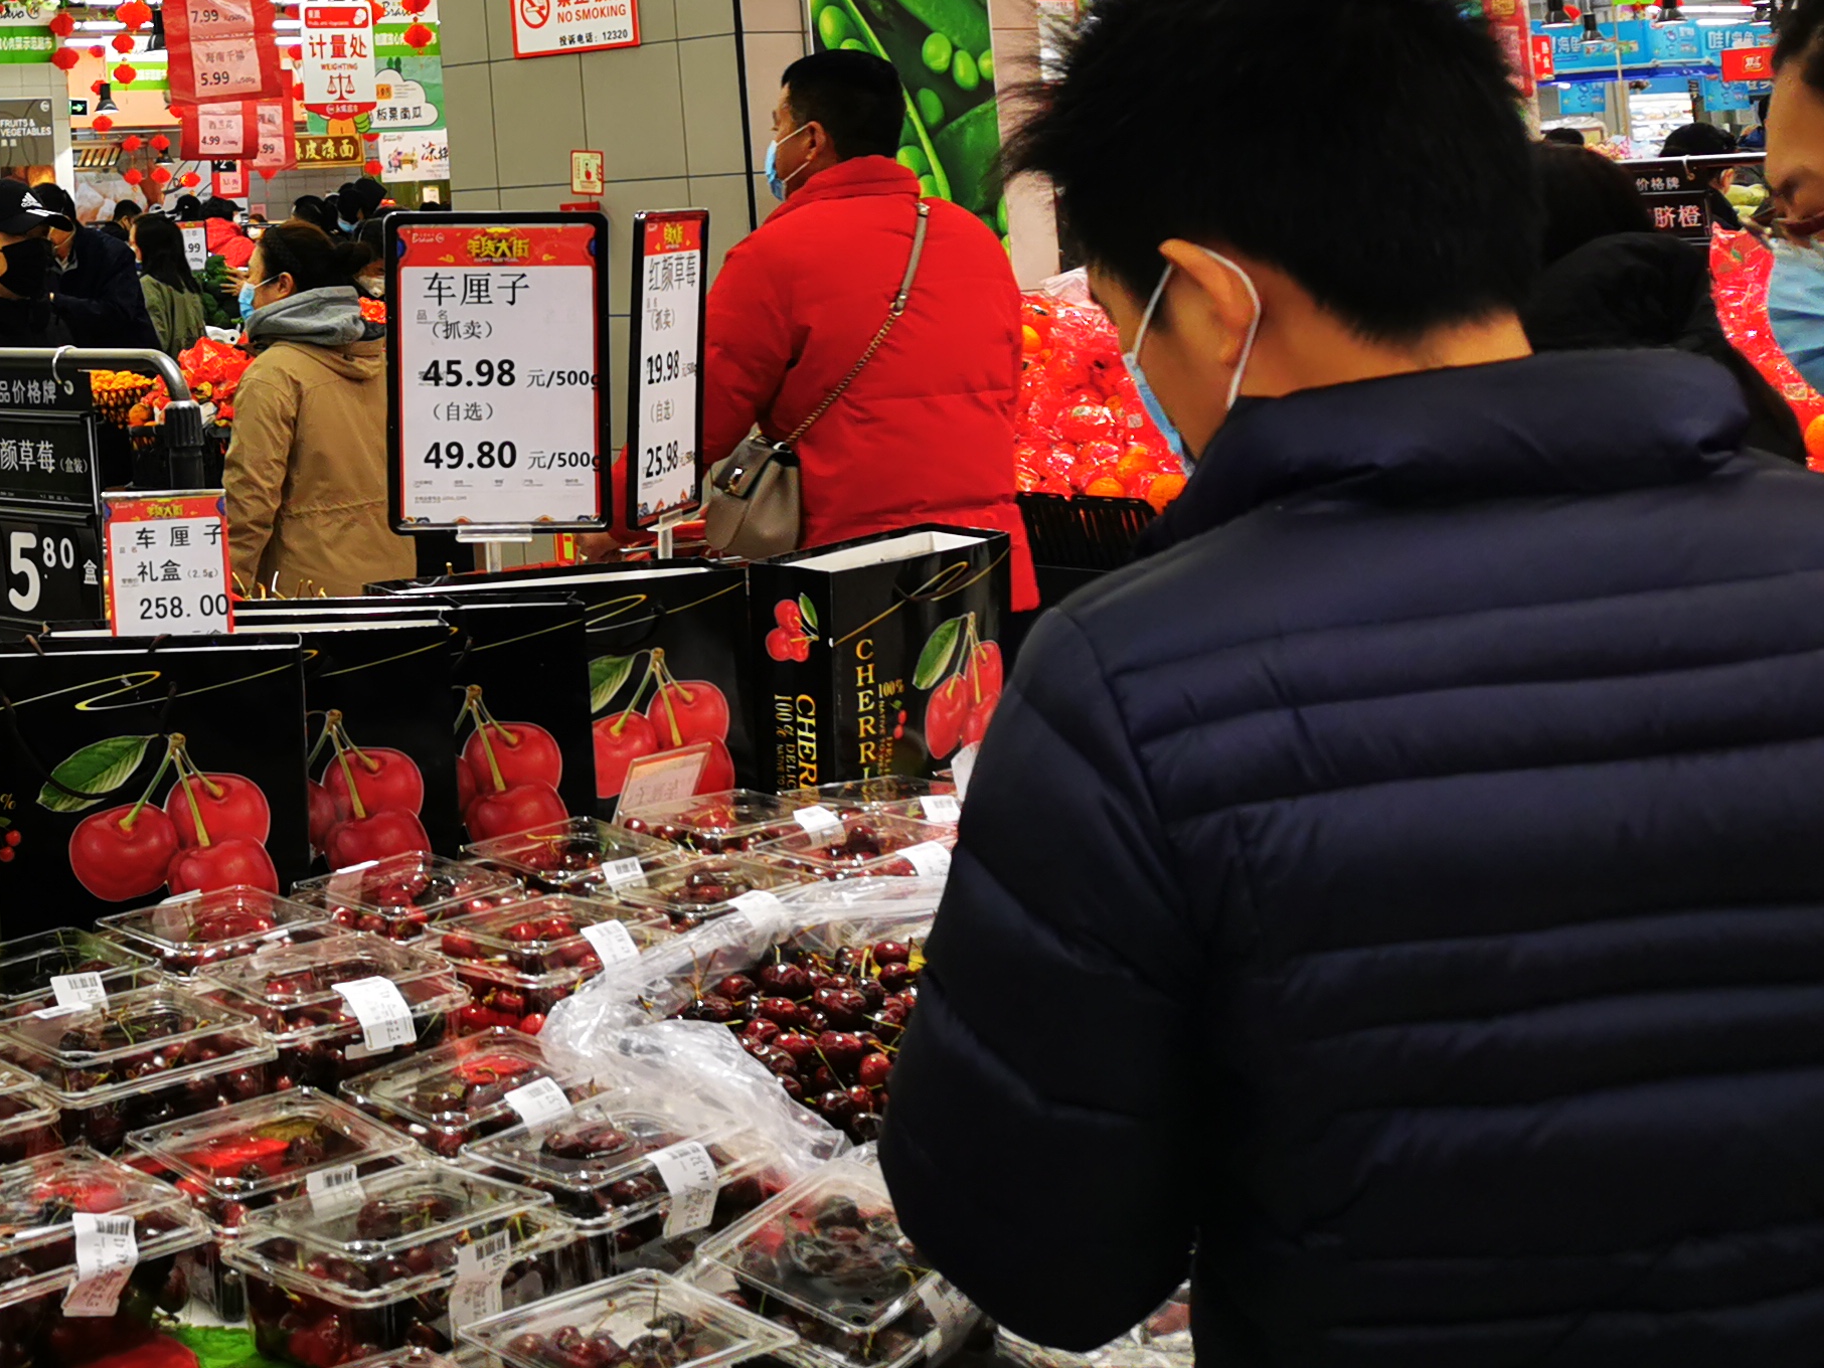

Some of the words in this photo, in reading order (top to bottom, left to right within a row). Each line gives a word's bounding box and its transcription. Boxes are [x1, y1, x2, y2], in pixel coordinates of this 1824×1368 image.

[190, 10, 219, 24] 7.99
[557, 11, 574, 23] NO
[575, 3, 627, 21] SMOKING
[602, 28, 628, 41] 12320
[308, 34, 368, 60] 计量处
[320, 62, 359, 71] WEIGHTING
[200, 71, 230, 86] 5.99
[0, 118, 29, 128] FRUITS
[0, 126, 52, 137] VEGETABLES
[200, 136, 220, 146] 4.99
[1652, 205, 1703, 229] 脐橙
[467, 237, 530, 259] 年货大街
[647, 252, 697, 292] 红颜草莓
[423, 272, 530, 307] 车厘子
[431, 319, 494, 340] （抓卖）
[423, 358, 516, 387] 45.98
[646, 349, 680, 386] 19.98
[432, 401, 496, 422] （自选）
[423, 440, 517, 470] 49.80
[645, 439, 679, 479] 25.98
[136, 524, 223, 549] 车厘子
[137, 559, 181, 583] 礼盒
[140, 594, 229, 620] 258.00
